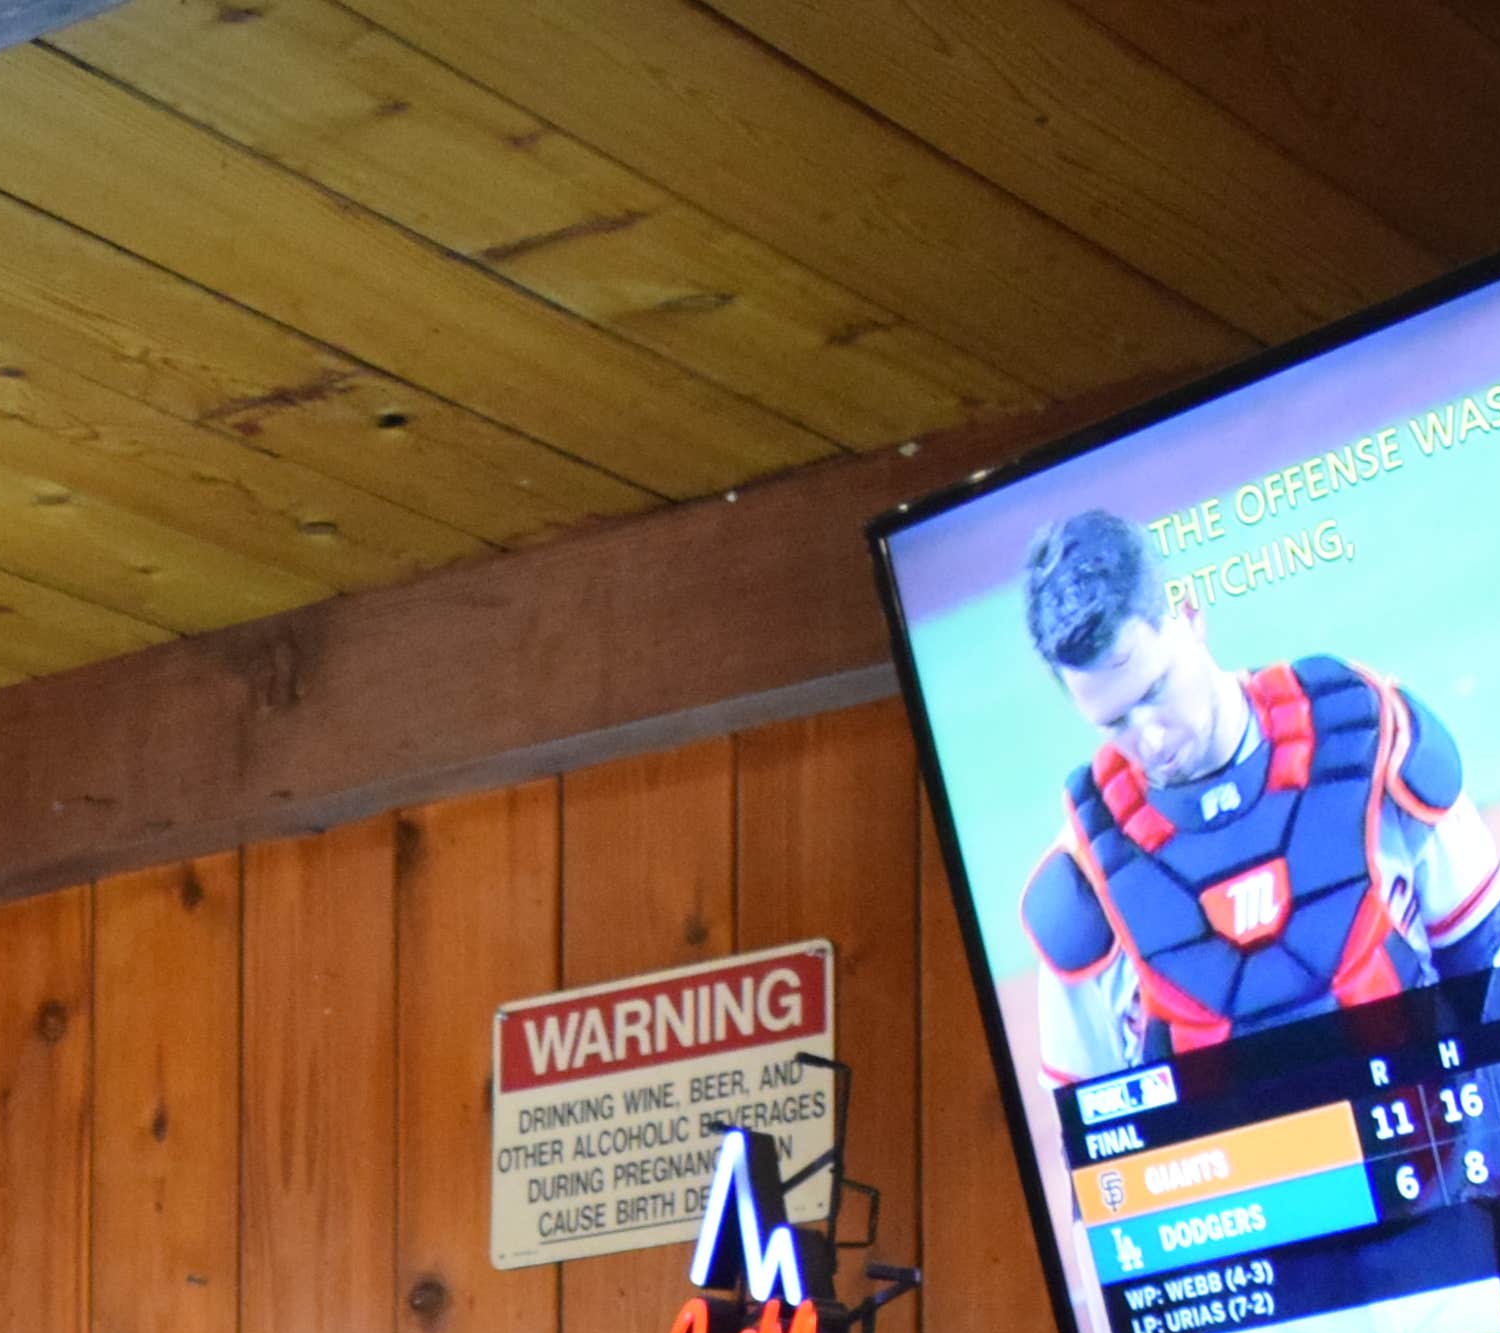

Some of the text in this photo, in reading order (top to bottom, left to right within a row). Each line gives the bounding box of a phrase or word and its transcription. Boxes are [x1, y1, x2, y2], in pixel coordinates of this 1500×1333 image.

[1149, 497, 1226, 557] THE
[1234, 427, 1404, 527] OFFENSE
[1163, 518, 1357, 617] PITCHING,
[524, 967, 804, 1077] WARNING
[1369, 1058, 1389, 1087] R
[1438, 1039, 1462, 1070] H
[518, 1092, 615, 1136] DRINKING
[689, 1068, 751, 1105] BEER,
[760, 1059, 803, 1091] AND
[498, 1134, 565, 1175] OTHER
[574, 1113, 690, 1162] ALCOHOLIC
[1086, 1125, 1145, 1160] FINAL
[1145, 1149, 1231, 1195] GIANTS
[1370, 1100, 1415, 1141] 11
[1439, 1082, 1485, 1124] 16
[528, 1163, 605, 1205] DURING
[1159, 1204, 1267, 1252] DODGERS
[1395, 1165, 1420, 1200] 6
[1463, 1150, 1489, 1184] 8
[538, 1202, 607, 1239] CAUSE
[616, 1192, 676, 1226] BIRTH
[1124, 1260, 1275, 1312] WP: WEBB (4-3)
[1229, 1293, 1275, 1325] (7-2)
